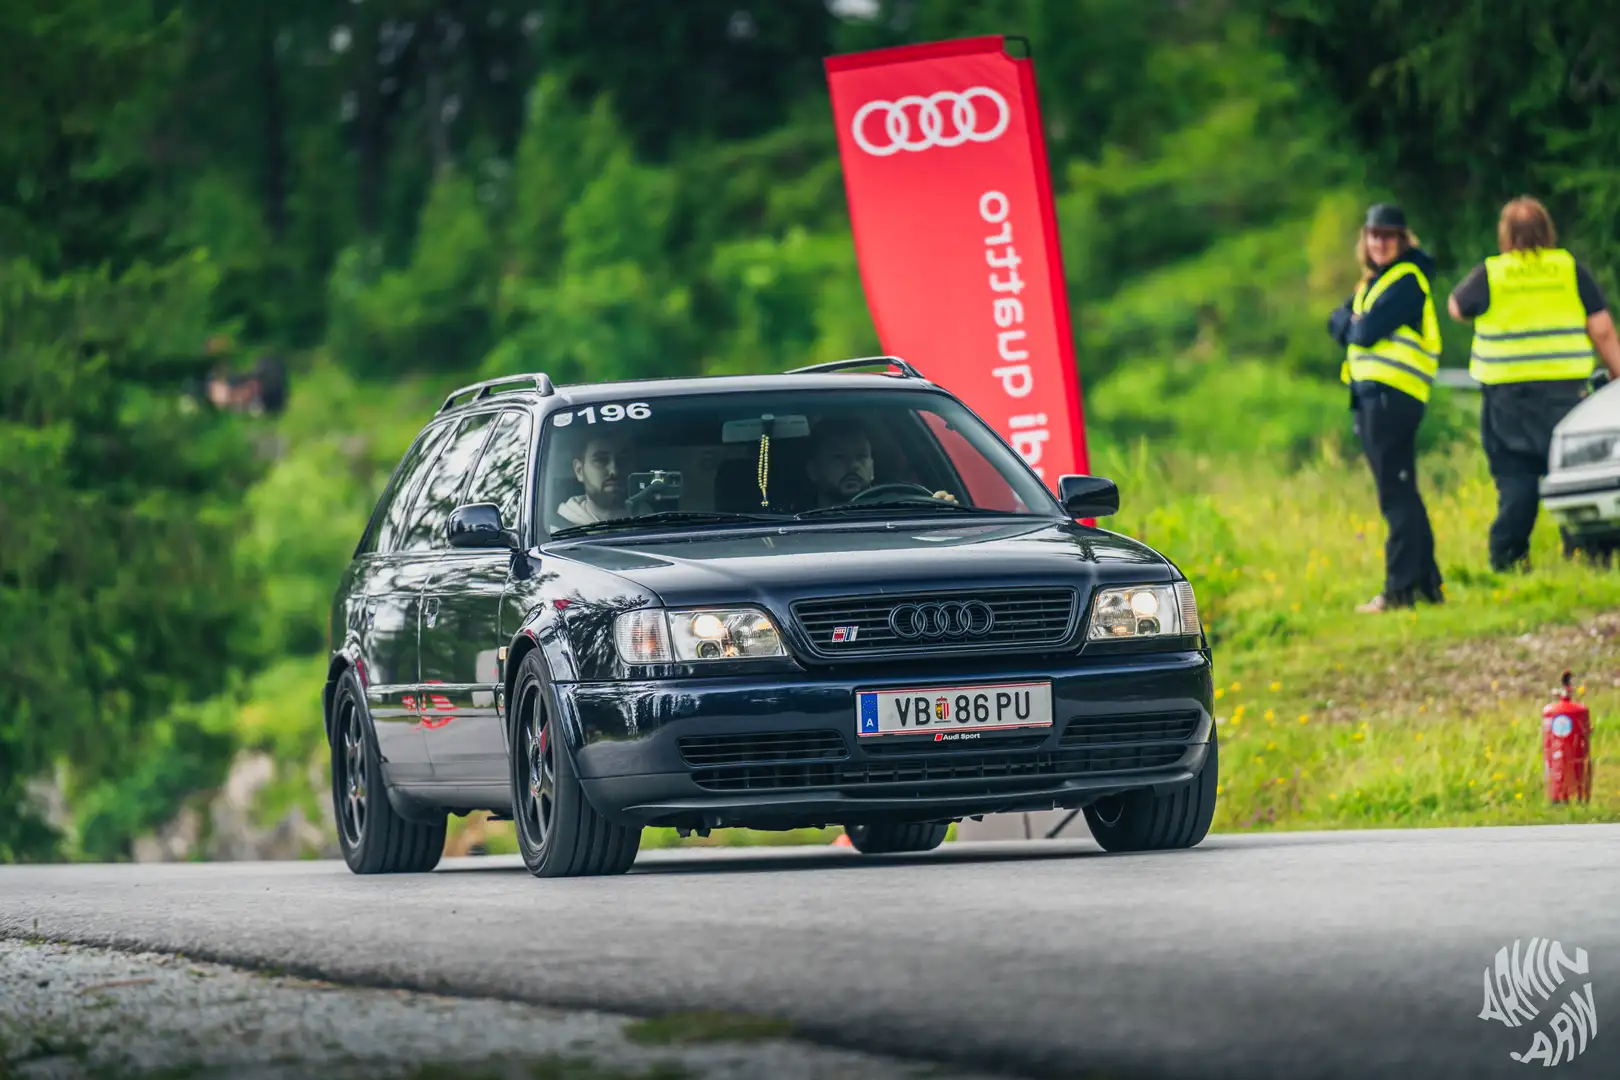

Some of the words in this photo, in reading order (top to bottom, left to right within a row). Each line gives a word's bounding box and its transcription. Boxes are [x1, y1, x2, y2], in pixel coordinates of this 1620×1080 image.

[577, 402, 652, 425] 196
[895, 697, 931, 727] VB
[955, 694, 989, 723] 86
[997, 691, 1030, 721] PU
[866, 718, 874, 727] A
[942, 733, 960, 741] Audi
[960, 732, 981, 740] Sport
